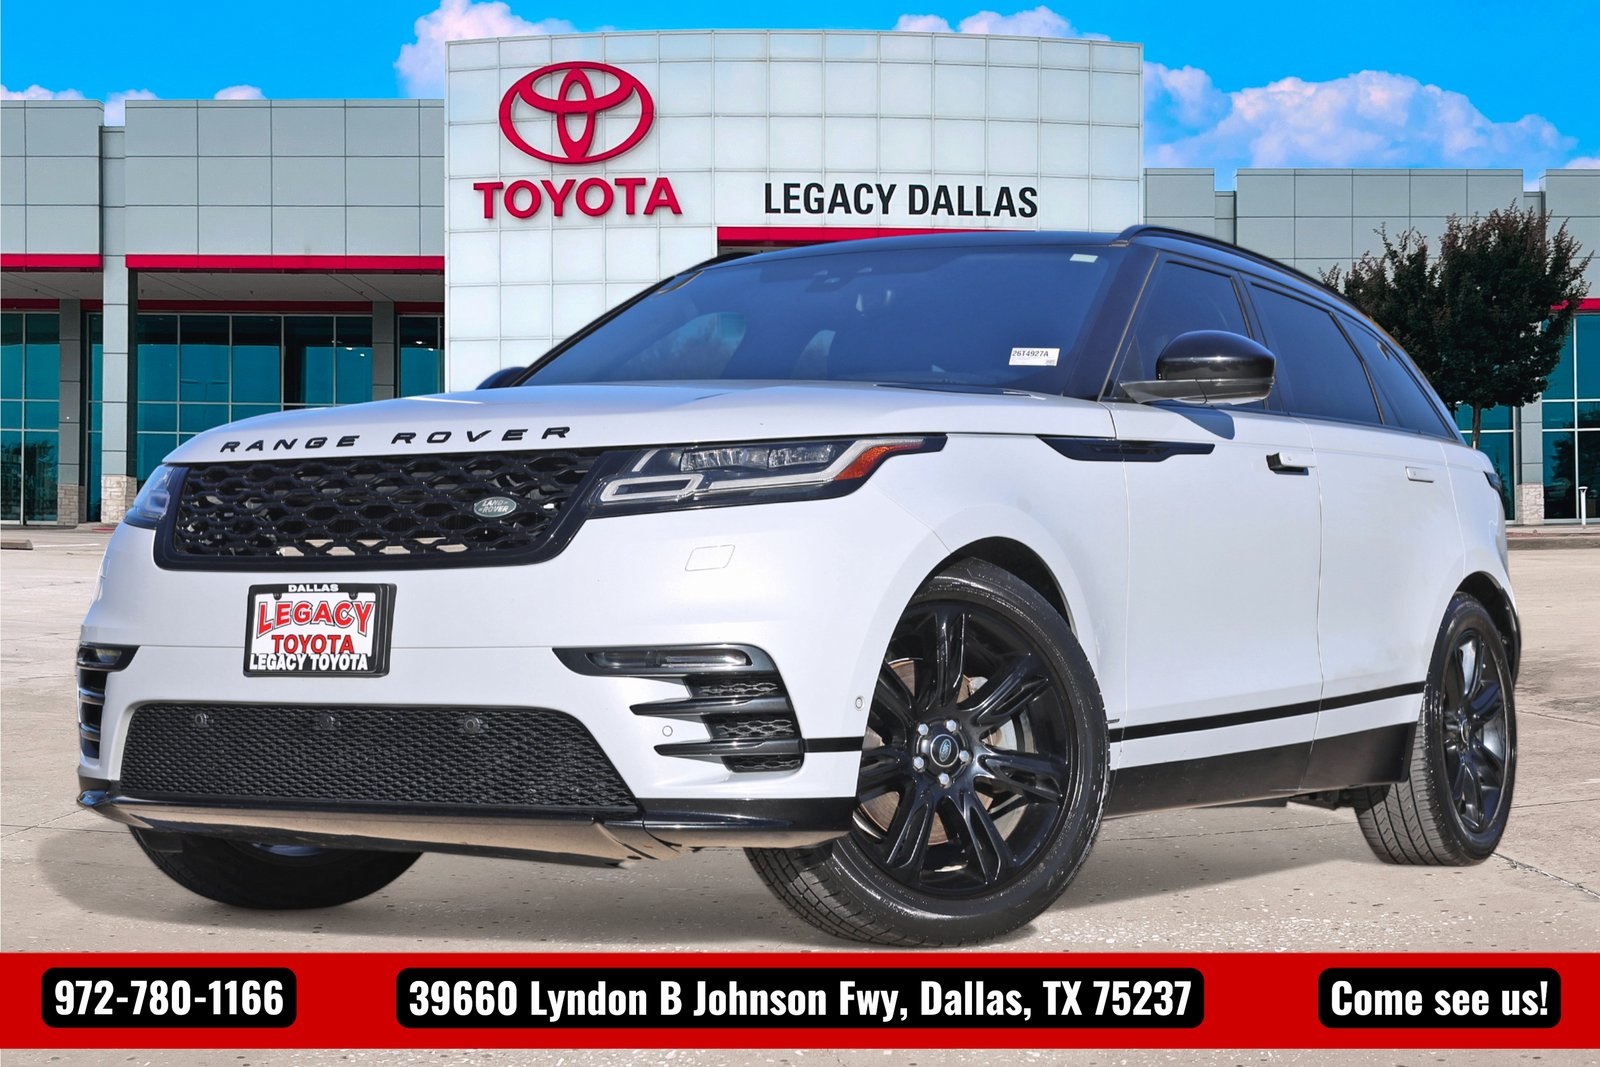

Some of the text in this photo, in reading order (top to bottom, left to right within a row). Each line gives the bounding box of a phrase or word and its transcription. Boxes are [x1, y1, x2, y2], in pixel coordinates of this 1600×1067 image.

[473, 177, 682, 219] TOYOTA
[764, 182, 1038, 218] LEGACY DALLAS
[220, 426, 571, 453] RANGE ROVER
[482, 499, 504, 507] LAND
[482, 505, 509, 513] ROVER
[288, 584, 339, 592] DALLAS
[256, 600, 375, 639] LEGACY
[271, 633, 356, 654] TOYOTA
[249, 653, 368, 671] LEGACY TOYOTA
